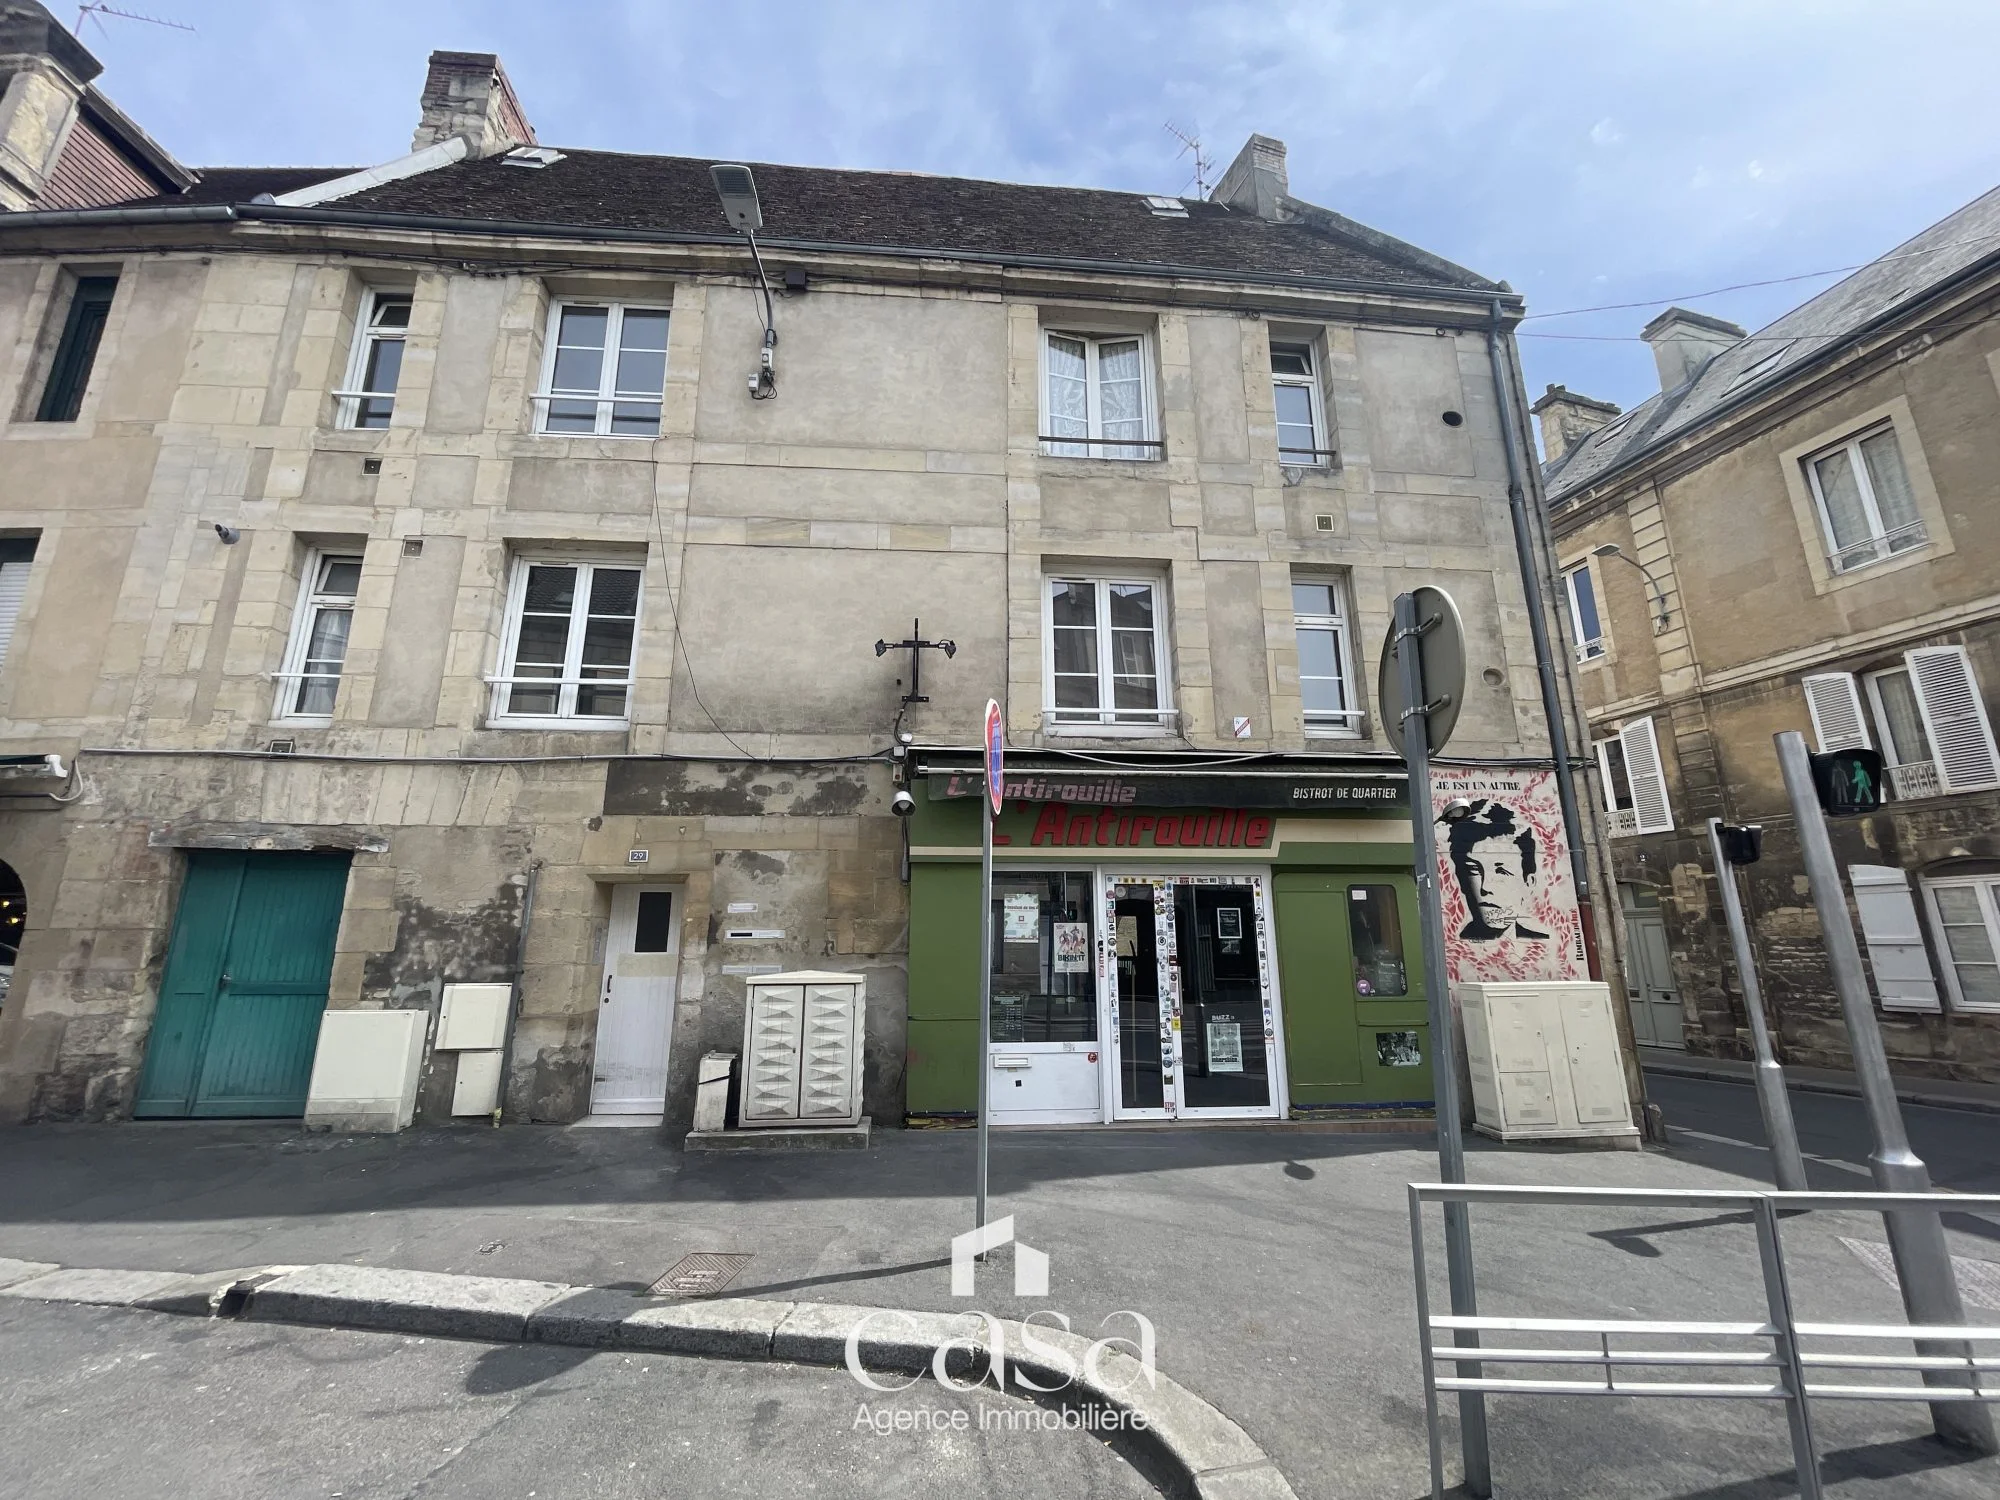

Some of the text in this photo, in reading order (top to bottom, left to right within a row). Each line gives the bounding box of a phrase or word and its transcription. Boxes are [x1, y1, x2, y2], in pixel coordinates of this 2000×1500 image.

[946, 775, 1137, 803] L'ntirouille
[1436, 781, 1521, 791] JE EST UN AUTRE
[1292, 787, 1397, 799] BISTROT DE QUARTIER
